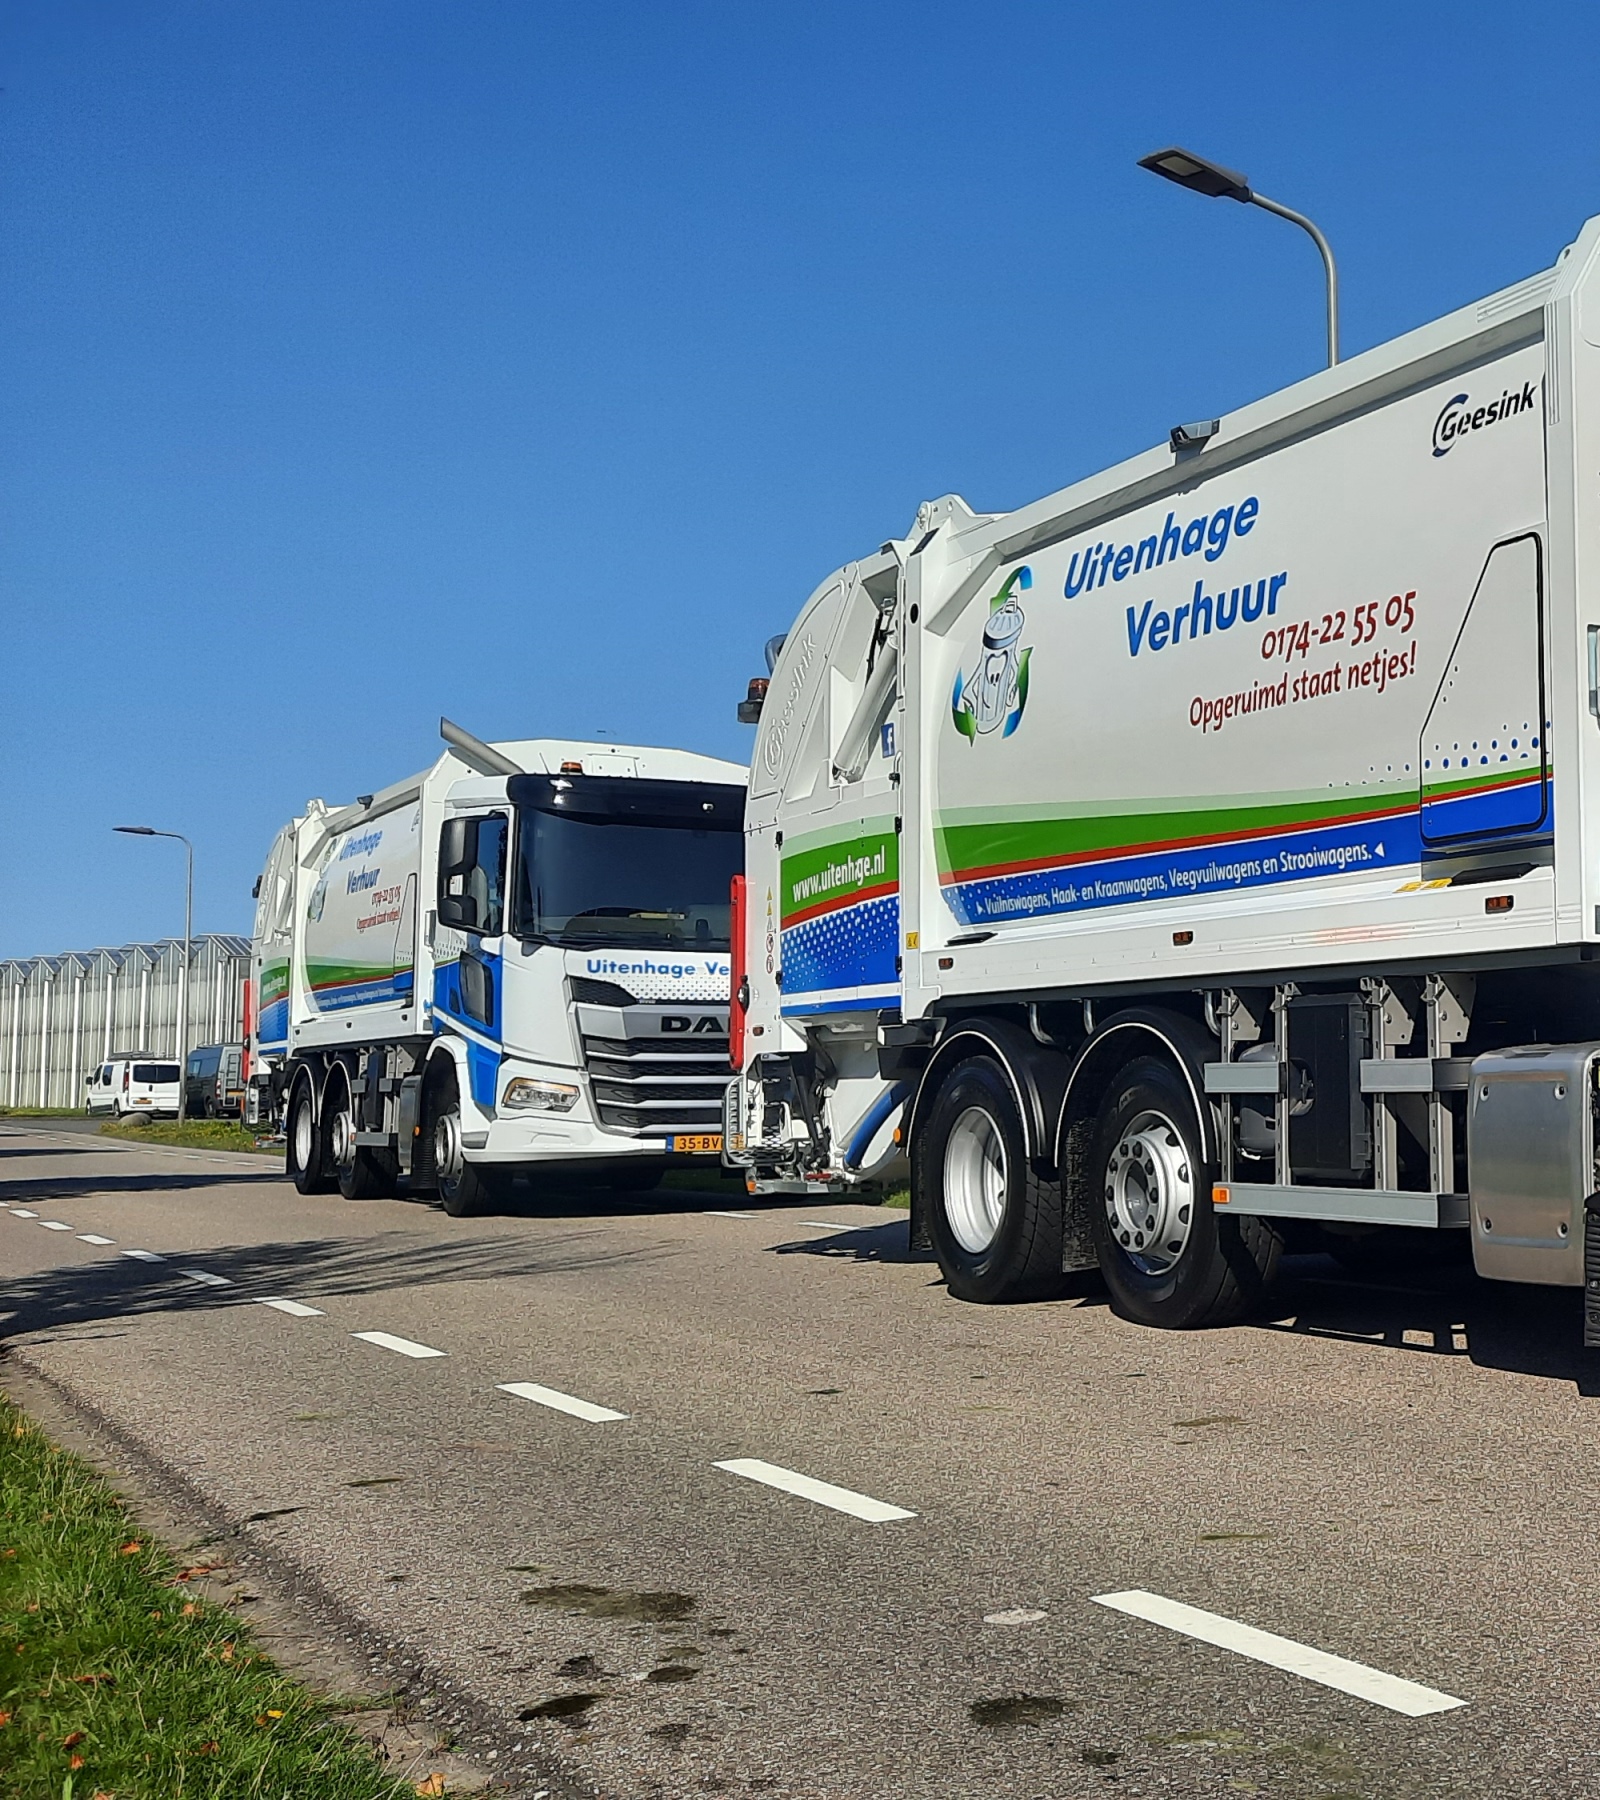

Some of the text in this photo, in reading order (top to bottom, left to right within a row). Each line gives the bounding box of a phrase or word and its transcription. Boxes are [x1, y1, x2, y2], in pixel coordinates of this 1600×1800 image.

[1432, 380, 1538, 458] Geesink
[1063, 496, 1260, 601] Uitenhage
[1126, 571, 1288, 658] Verhuur
[1261, 591, 1417, 663] 0174-22 55 05
[1189, 640, 1417, 734] Opgeruimd staat netjes!
[984, 842, 1373, 916] Vuilniswagens, Haak- en Kraanwagens, Veegvuilwagens en Strooiwagens.
[586, 959, 730, 979] Uitenhage Ve
[661, 1015, 730, 1033] DA
[679, 1136, 723, 1150] 35-BV
